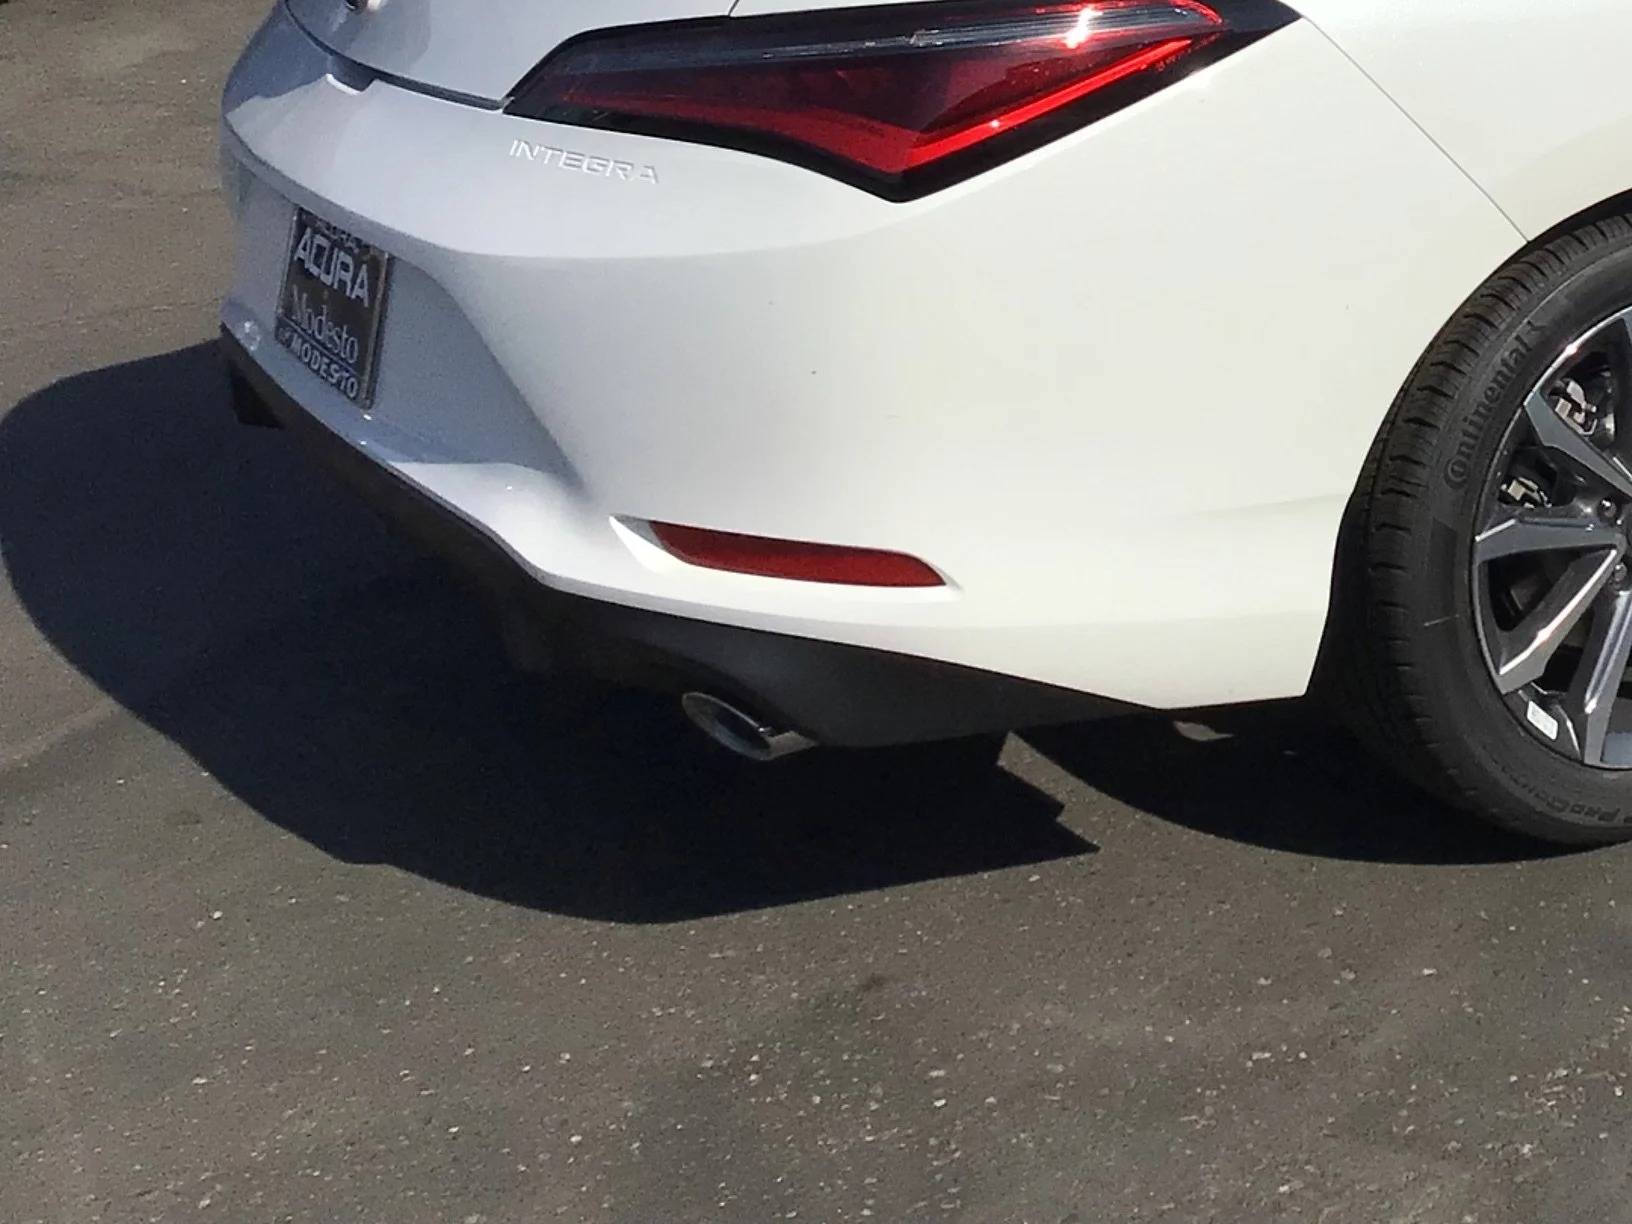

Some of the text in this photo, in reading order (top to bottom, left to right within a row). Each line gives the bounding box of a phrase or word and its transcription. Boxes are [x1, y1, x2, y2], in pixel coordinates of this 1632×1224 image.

[509, 139, 658, 184] INTEGRA
[294, 227, 369, 308] ACURA
[292, 284, 359, 364] Modesto
[291, 337, 359, 398] MODESTO
[1444, 334, 1533, 489] Continental
